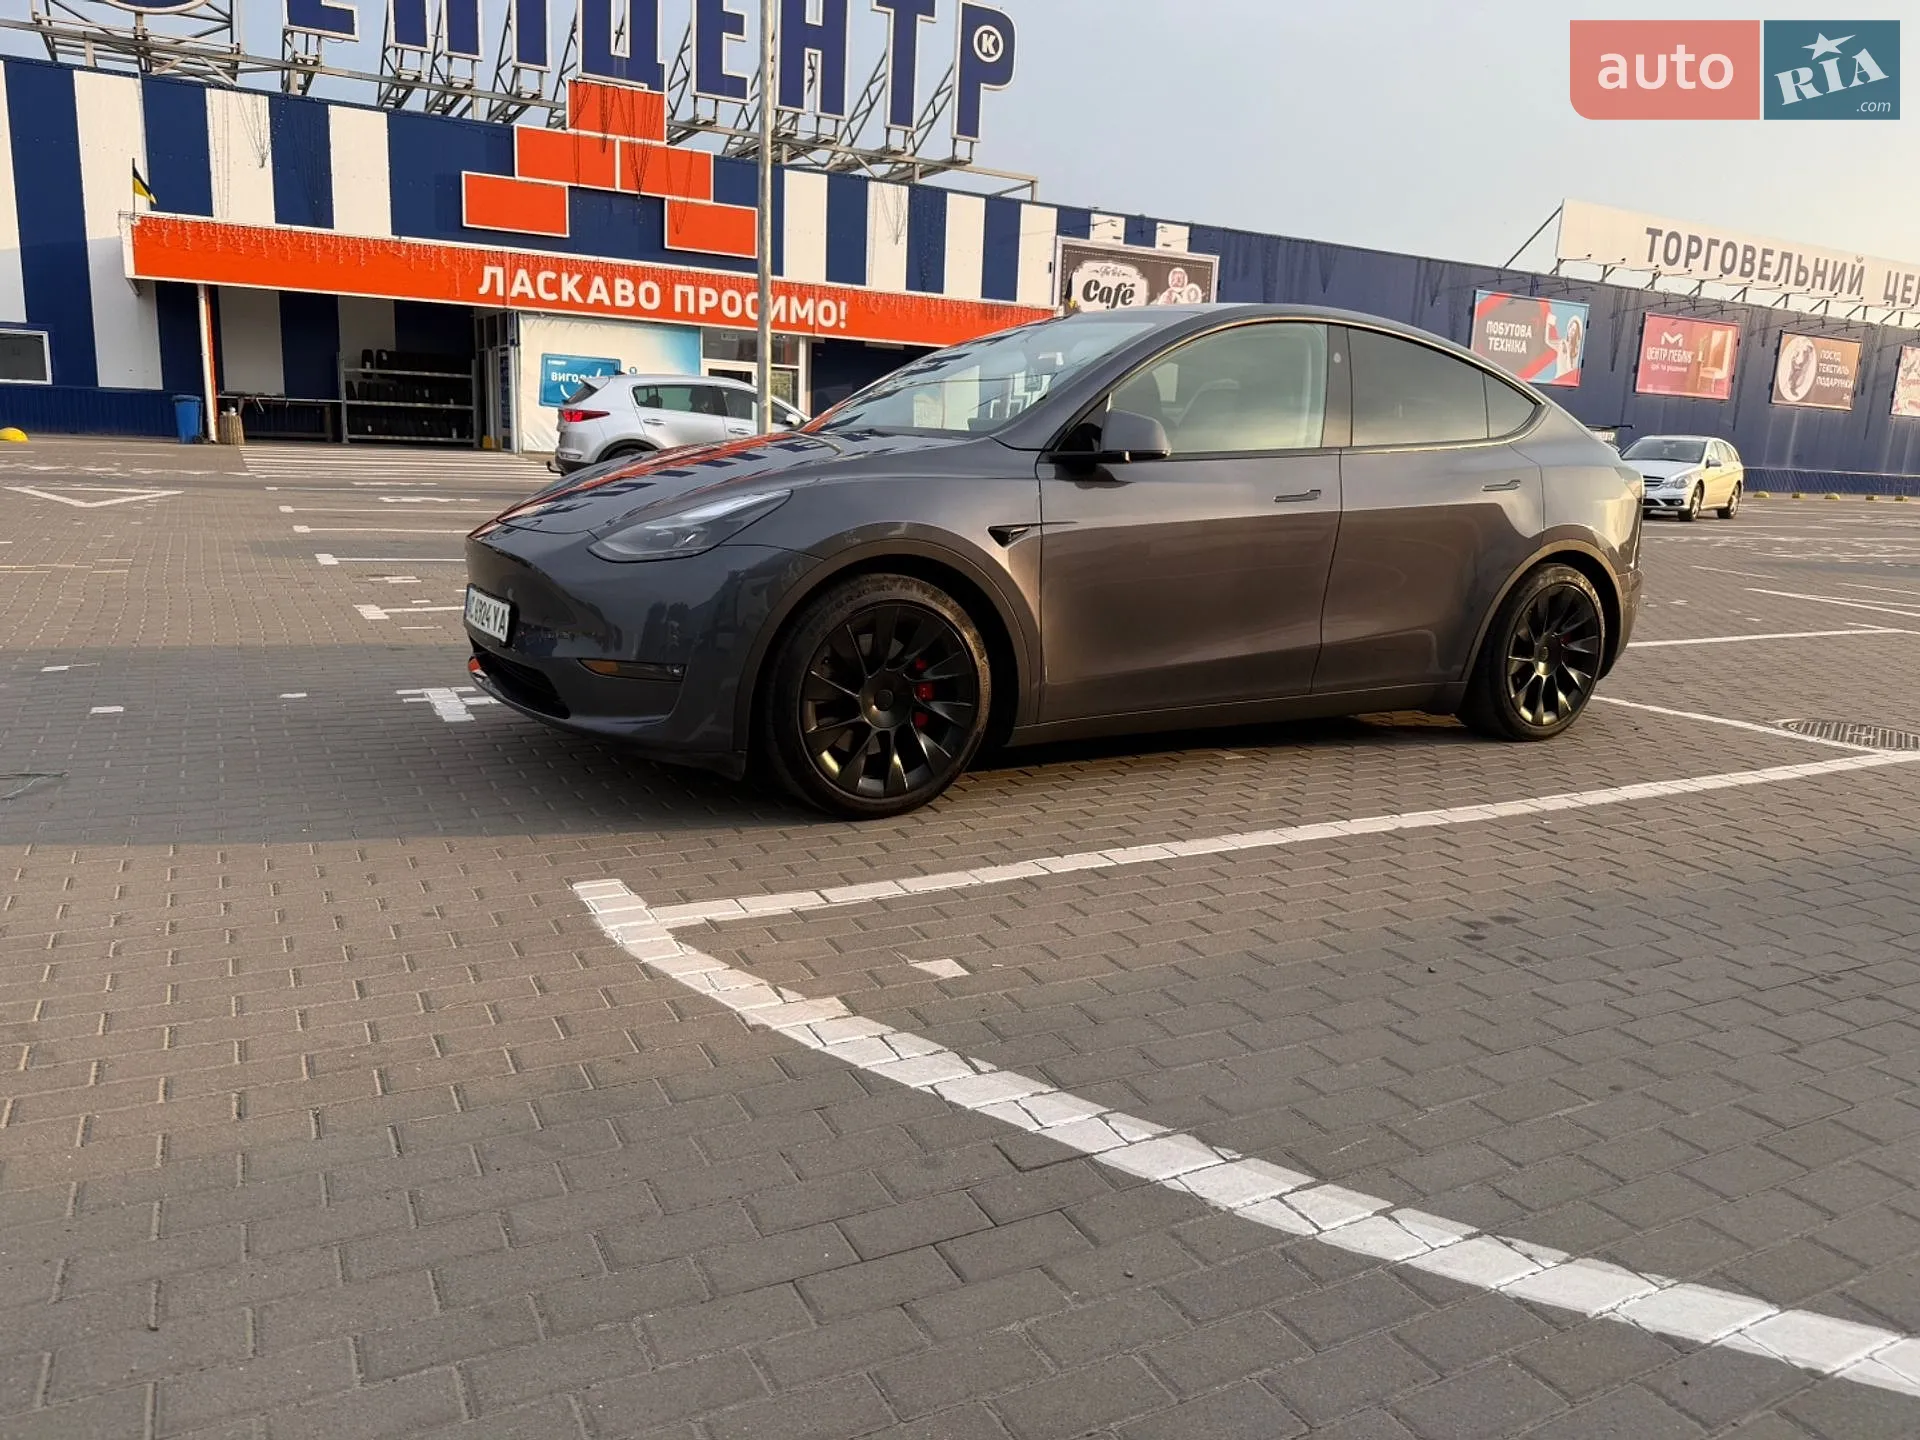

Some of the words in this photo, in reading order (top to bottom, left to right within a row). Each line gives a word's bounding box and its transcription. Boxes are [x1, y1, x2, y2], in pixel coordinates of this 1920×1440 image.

[1646, 227, 1865, 296] ТОРГОВЕЛЬНИЙ
[1883, 270, 1920, 307] ЦЕ
[478, 265, 661, 310] ЛАСКАВО
[674, 284, 847, 329] ПРОСИМО!
[1082, 279, 1136, 310] Café
[1486, 320, 1532, 338] ПОБУТОВА
[1488, 337, 1527, 354] ТЕХНІКА
